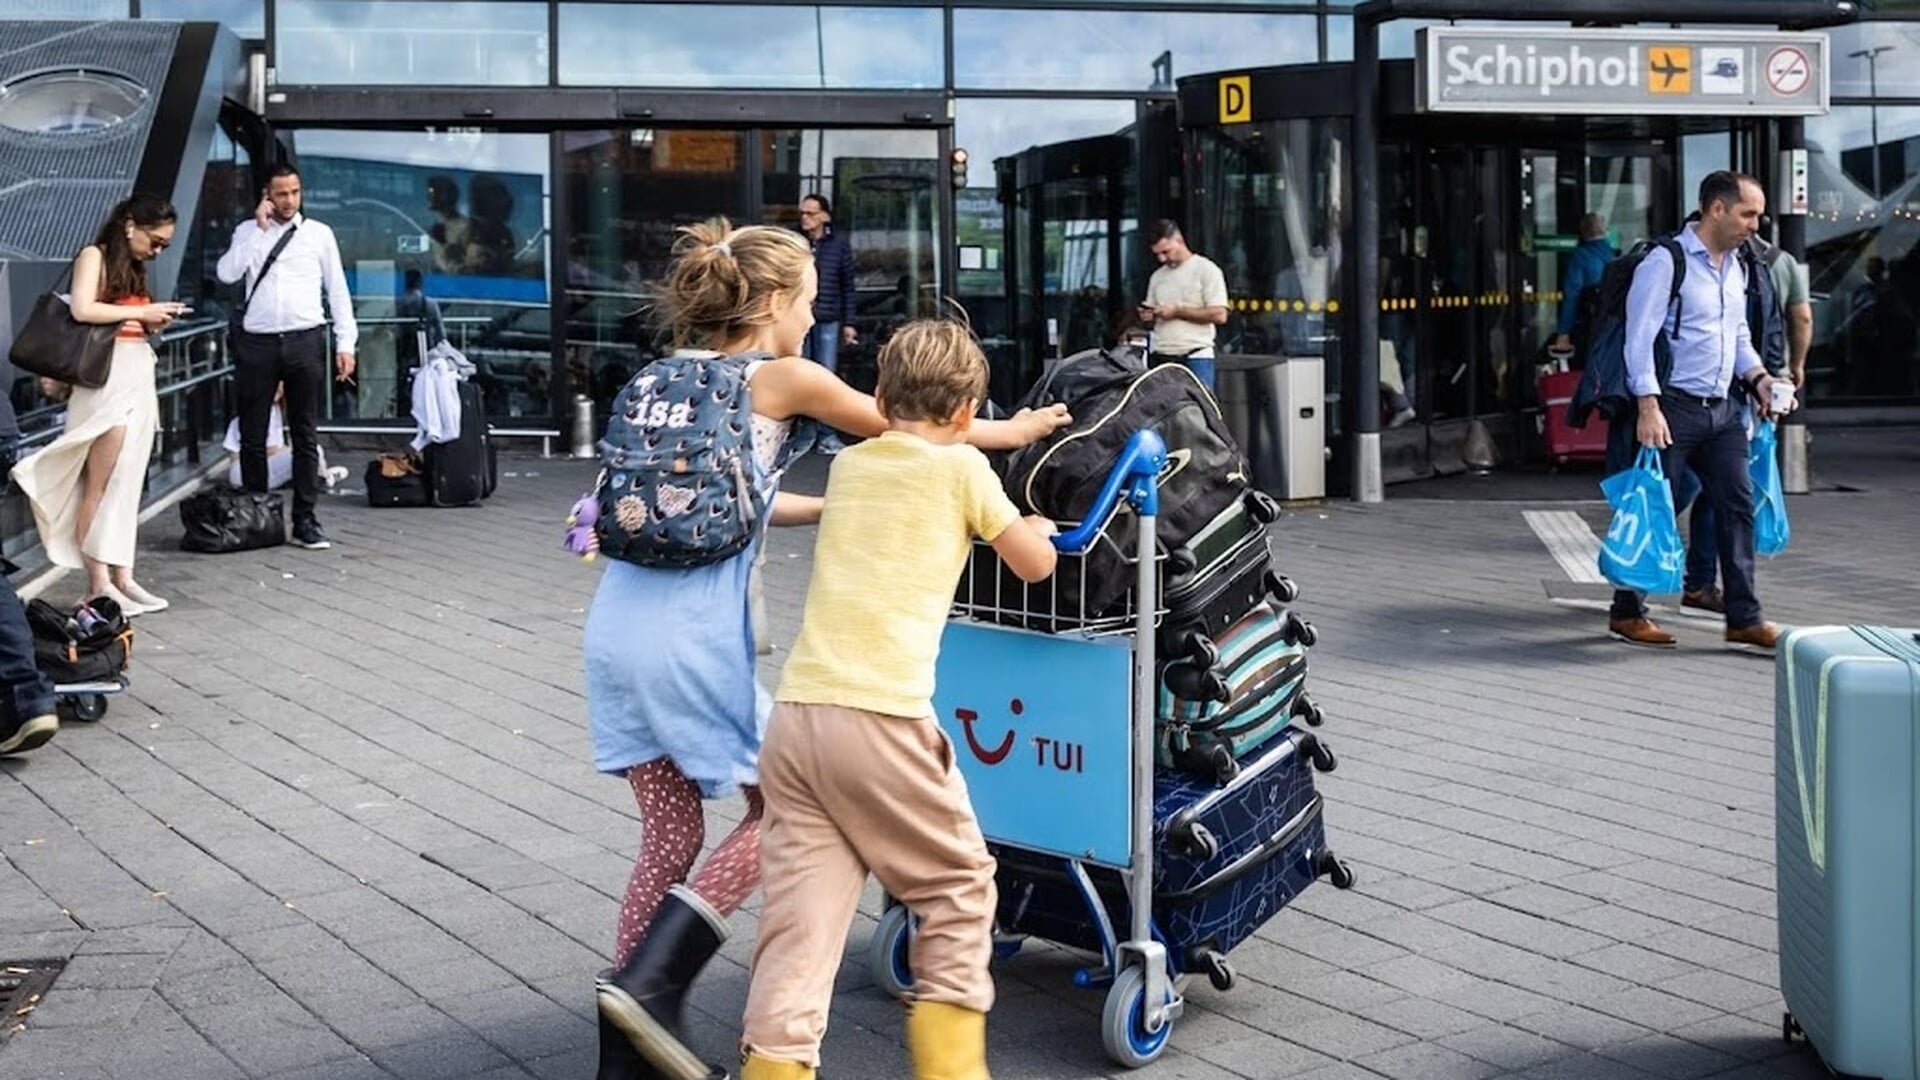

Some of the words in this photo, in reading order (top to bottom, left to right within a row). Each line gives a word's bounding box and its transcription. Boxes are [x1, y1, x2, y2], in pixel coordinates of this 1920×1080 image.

[1445, 44, 1639, 95] Schiphol
[1226, 84, 1244, 116] D
[1034, 737, 1083, 773] TUI
